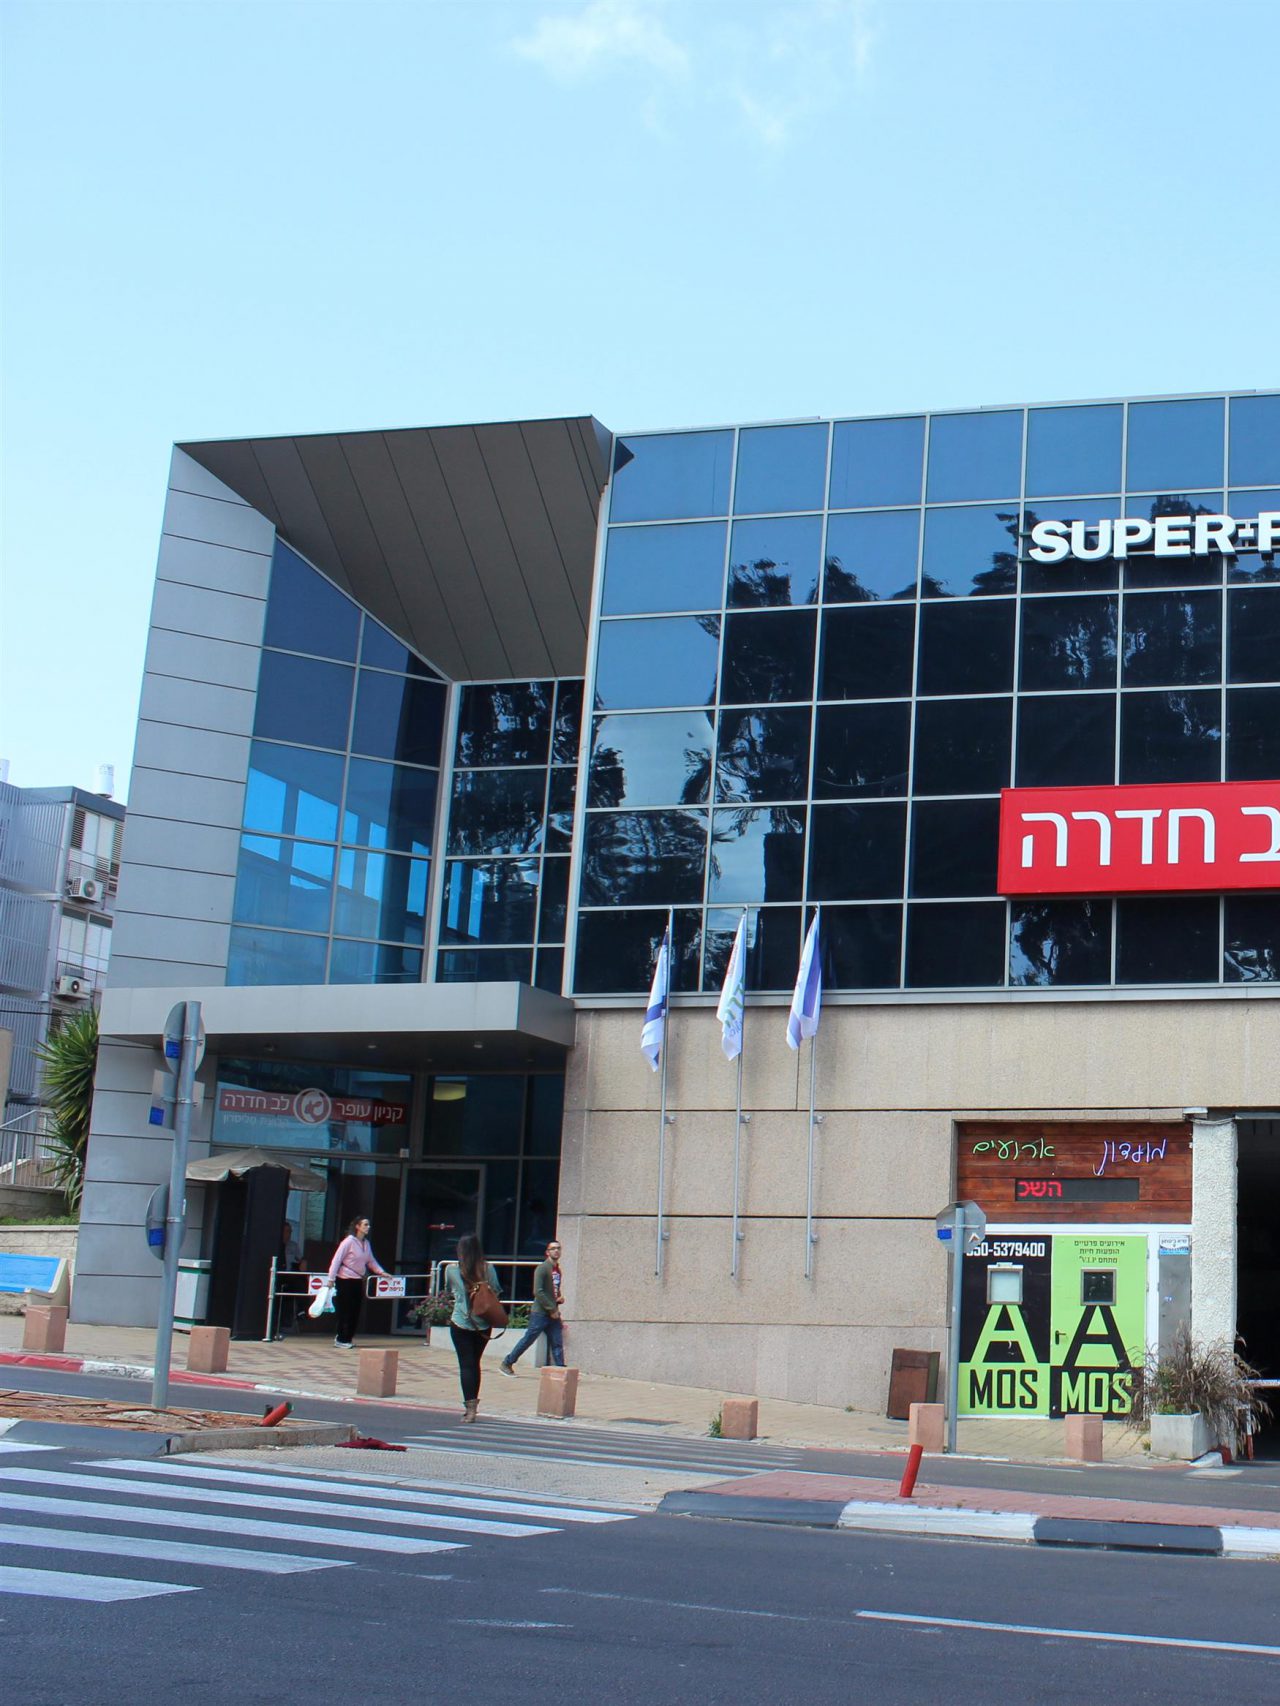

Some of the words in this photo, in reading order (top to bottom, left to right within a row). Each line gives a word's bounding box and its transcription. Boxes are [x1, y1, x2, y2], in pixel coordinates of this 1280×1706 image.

[1020, 807, 1216, 869] חדרה
[224, 1094, 267, 1109] חדרה
[271, 1095, 290, 1111] לב
[336, 1102, 371, 1118] עופר
[374, 1104, 404, 1122] קניון
[972, 1138, 1056, 1161] ארועים
[1093, 1138, 1167, 1176] מועדון
[969, 1369, 1038, 1410] MOS
[1061, 1371, 1134, 1413] MOS
